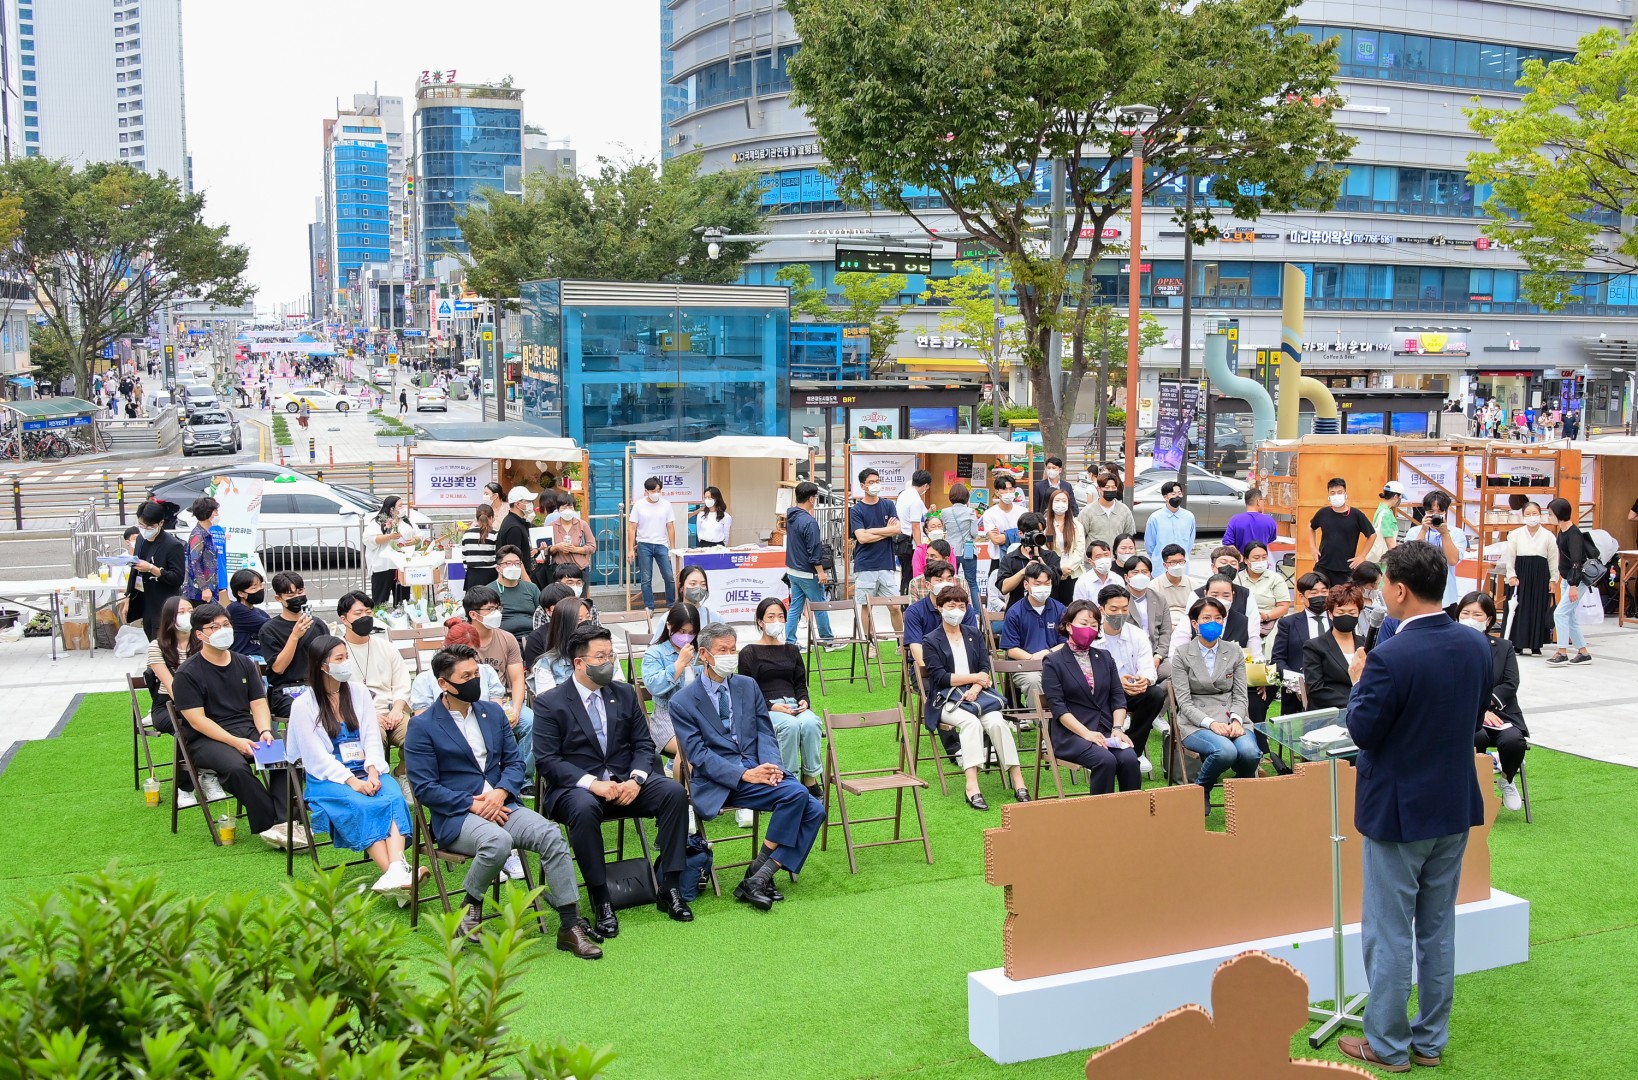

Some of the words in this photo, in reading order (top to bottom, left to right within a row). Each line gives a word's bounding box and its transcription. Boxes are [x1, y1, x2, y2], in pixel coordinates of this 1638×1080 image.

[1359, 43, 1373, 53] 임대
[1290, 230, 1353, 245] 미리퓨어왁싱
[487, 343, 492, 352] 5
[1232, 344, 1237, 354] 7
[1302, 342, 1329, 352] 카페
[1335, 340, 1373, 354] 해운대
[1375, 343, 1392, 351] 1994
[1259, 368, 1265, 378] 4
[1274, 368, 1281, 378] 4
[430, 476, 477, 488] 잎생꽃방
[725, 590, 762, 603] 에또농
